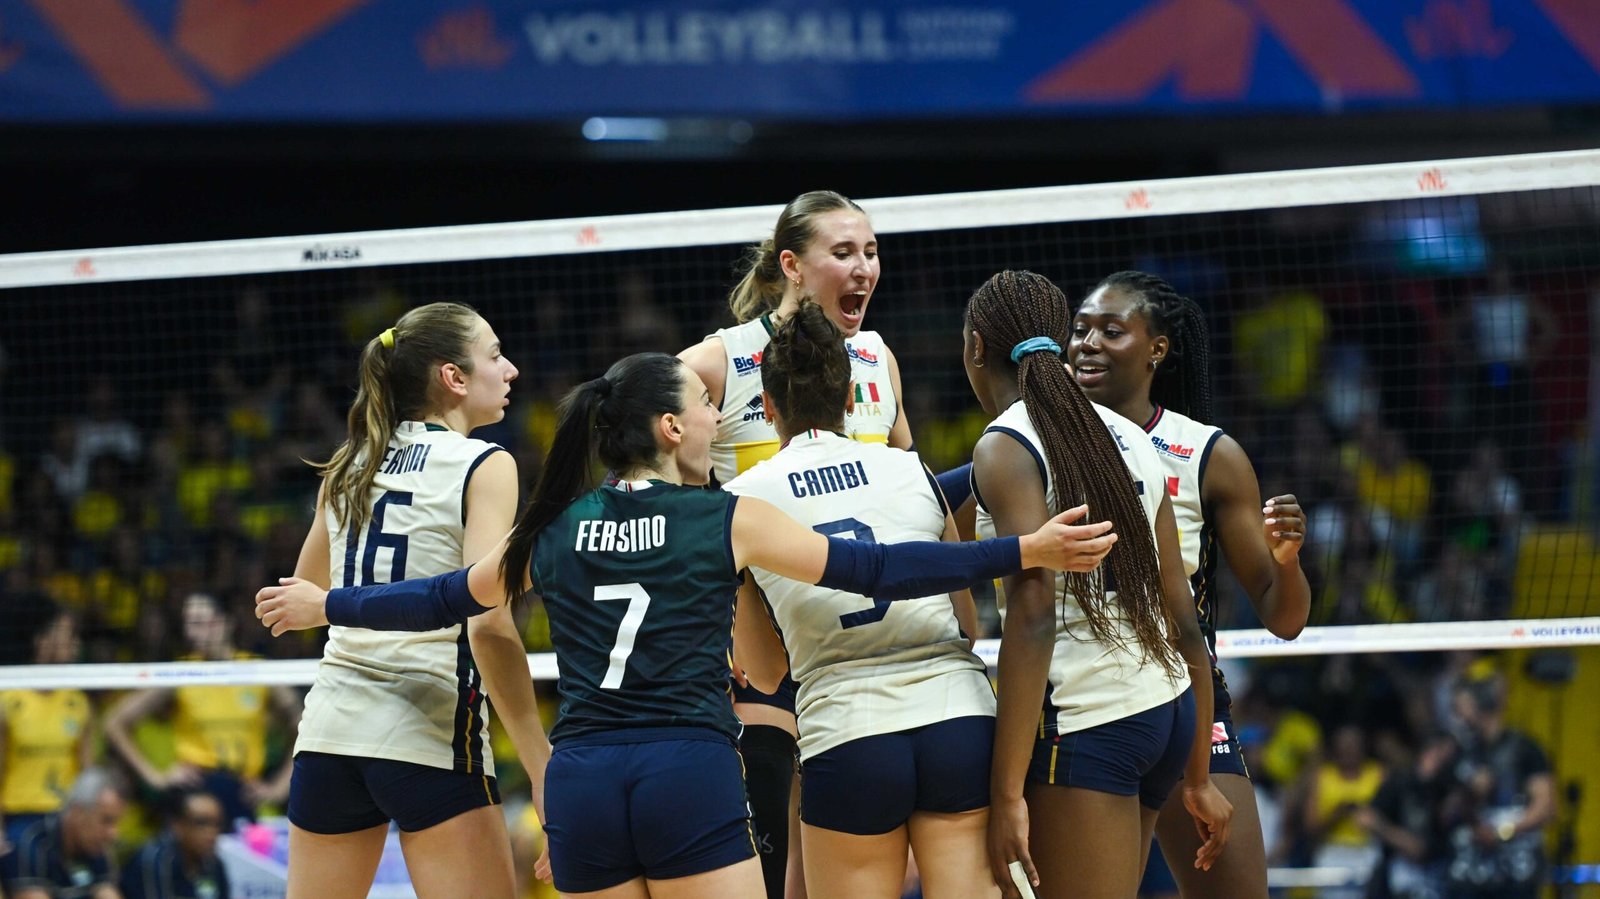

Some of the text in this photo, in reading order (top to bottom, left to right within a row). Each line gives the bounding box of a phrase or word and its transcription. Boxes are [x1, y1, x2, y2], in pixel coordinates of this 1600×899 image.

[524, 10, 890, 64] VOLLEYBALL
[733, 350, 763, 370] BigM
[743, 411, 766, 421] err
[858, 404, 882, 417] ITA
[377, 443, 432, 475] ERVINI
[1151, 435, 1194, 455] BigMat
[787, 460, 870, 499] CAMBI
[342, 489, 414, 589] 16
[574, 514, 667, 553] FERSINO
[593, 582, 652, 690] 7
[1211, 743, 1231, 755] rea
